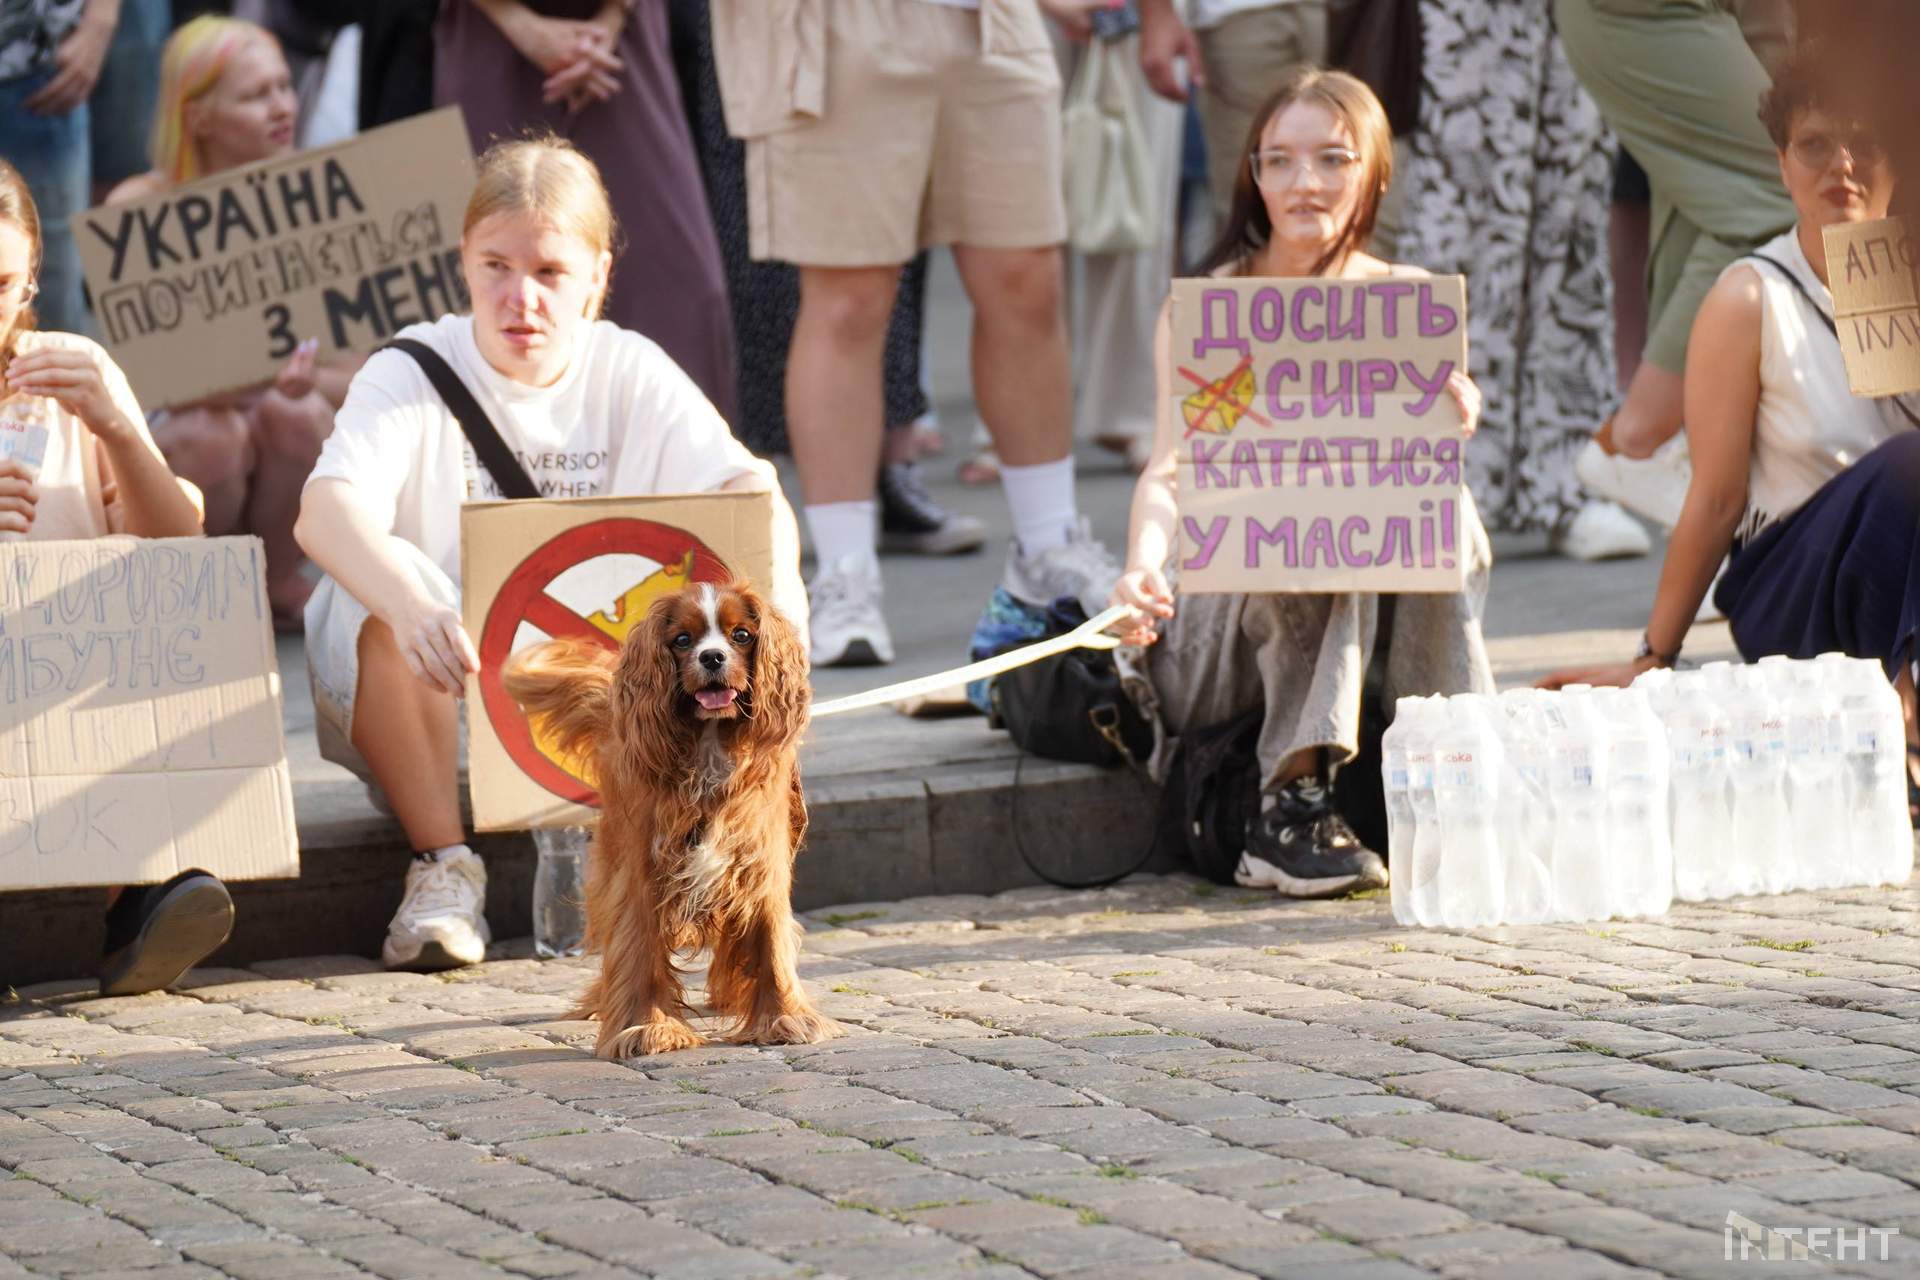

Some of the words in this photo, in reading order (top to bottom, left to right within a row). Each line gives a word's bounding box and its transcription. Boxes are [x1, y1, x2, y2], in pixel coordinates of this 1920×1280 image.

[87, 158, 364, 282] УКРАЇНА
[101, 203, 442, 344] ПОЧИНАЄТЬСЯ
[263, 304, 297, 359] З
[1193, 281, 1458, 359] ДОСИТЬ
[1265, 357, 1455, 420] СИРУ
[1192, 436, 1461, 488] КАТАТИСЯ
[1182, 515, 1231, 570] У
